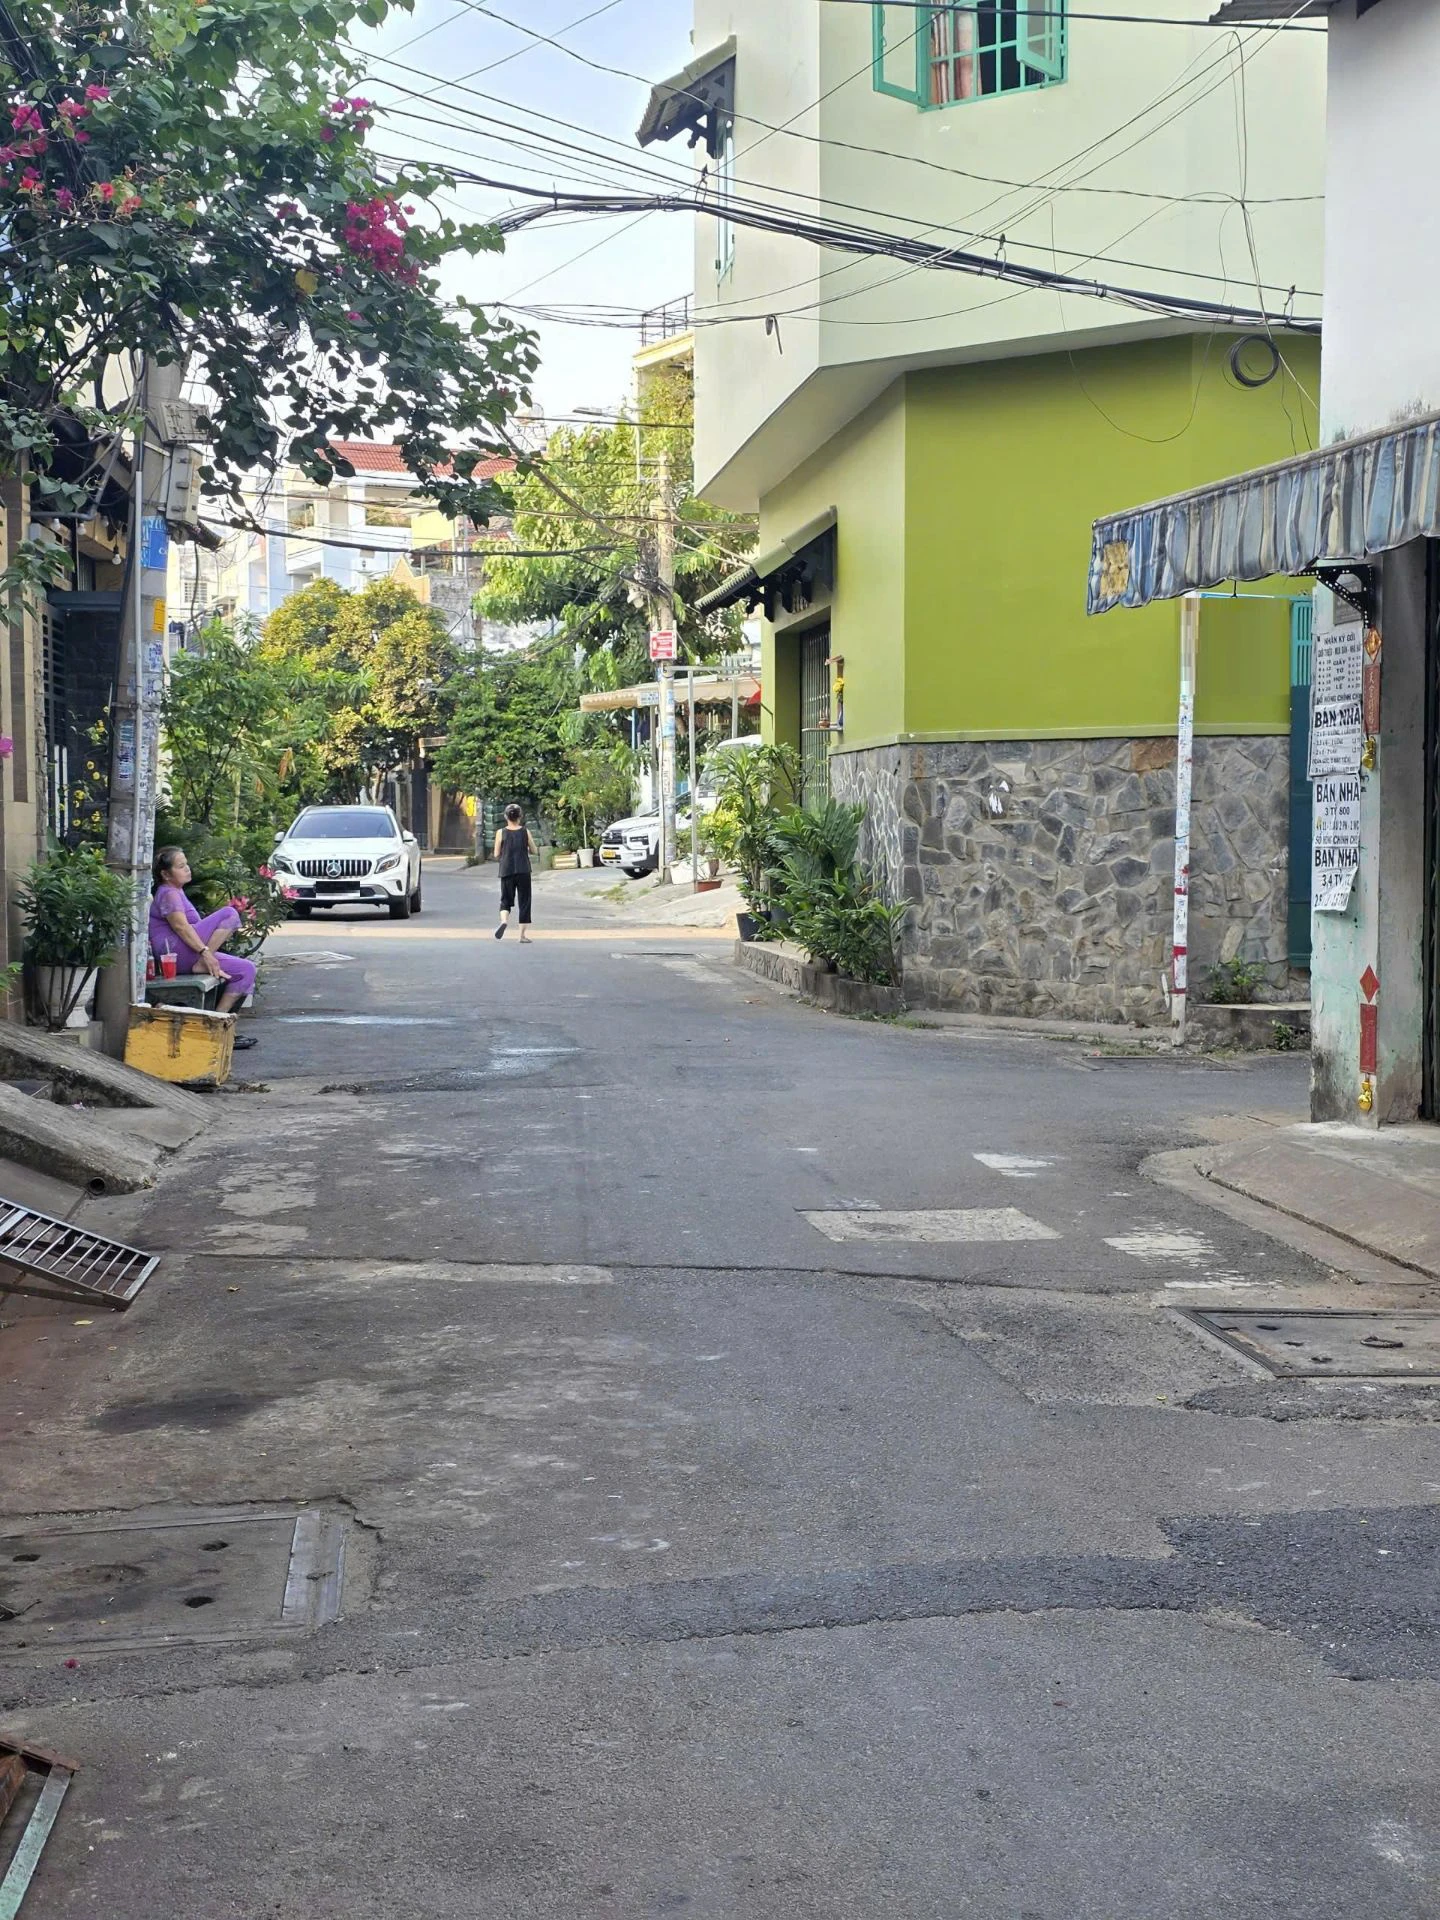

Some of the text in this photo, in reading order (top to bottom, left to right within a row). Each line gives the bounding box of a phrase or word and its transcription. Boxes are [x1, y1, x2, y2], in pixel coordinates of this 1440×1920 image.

[1314, 703, 1361, 729] BÁN NHÀ
[1316, 778, 1336, 803] BÁN
[1339, 776, 1360, 802] NHÀ
[1324, 807, 1329, 816] 3
